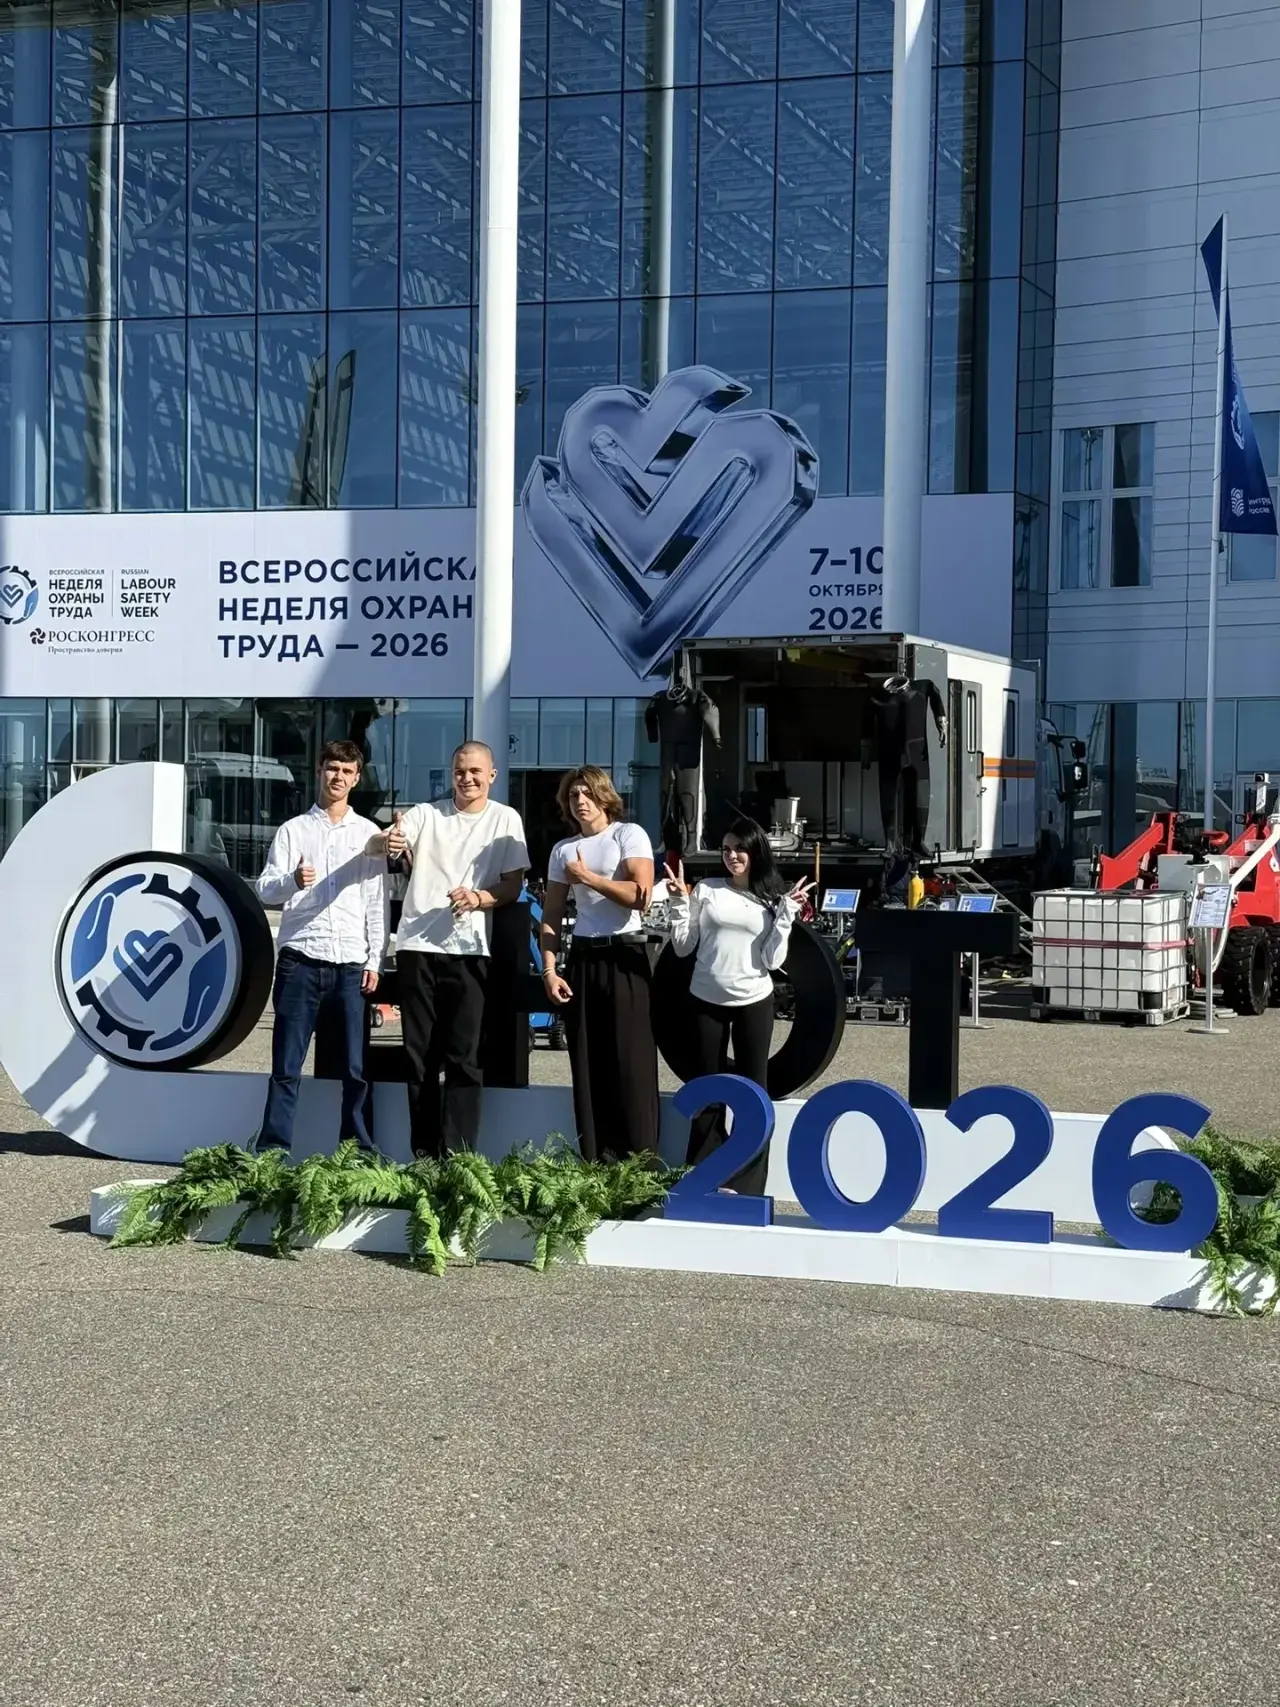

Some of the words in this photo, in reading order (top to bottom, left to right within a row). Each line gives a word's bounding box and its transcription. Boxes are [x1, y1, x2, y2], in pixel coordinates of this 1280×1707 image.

[48, 568, 105, 576] ВСЕРОССИЙСКАЯ
[120, 568, 150, 576] RUSSIAN
[218, 550, 476, 584] ВСЕРОССИЙСК
[48, 578, 103, 592] НЕДЕЛЯ
[120, 578, 176, 590] LABOUR
[808, 583, 883, 597] ОКТЯБР
[48, 592, 104, 604] ОХРАНЫ
[120, 592, 171, 604] SAFETY
[48, 606, 93, 619] ТРУДА
[120, 606, 159, 618] WEEK
[218, 597, 348, 625] НЕДЕЛЯ
[360, 594, 473, 620] ОХРАН
[808, 606, 882, 631] 2026
[48, 630, 156, 643] РОСКОНГРЕСС
[48, 646, 95, 655] Пространство
[96, 647, 123, 655] доверия
[217, 634, 325, 662] ТРУДА
[370, 632, 449, 657] 2026
[664, 1073, 1220, 1253] 2026
